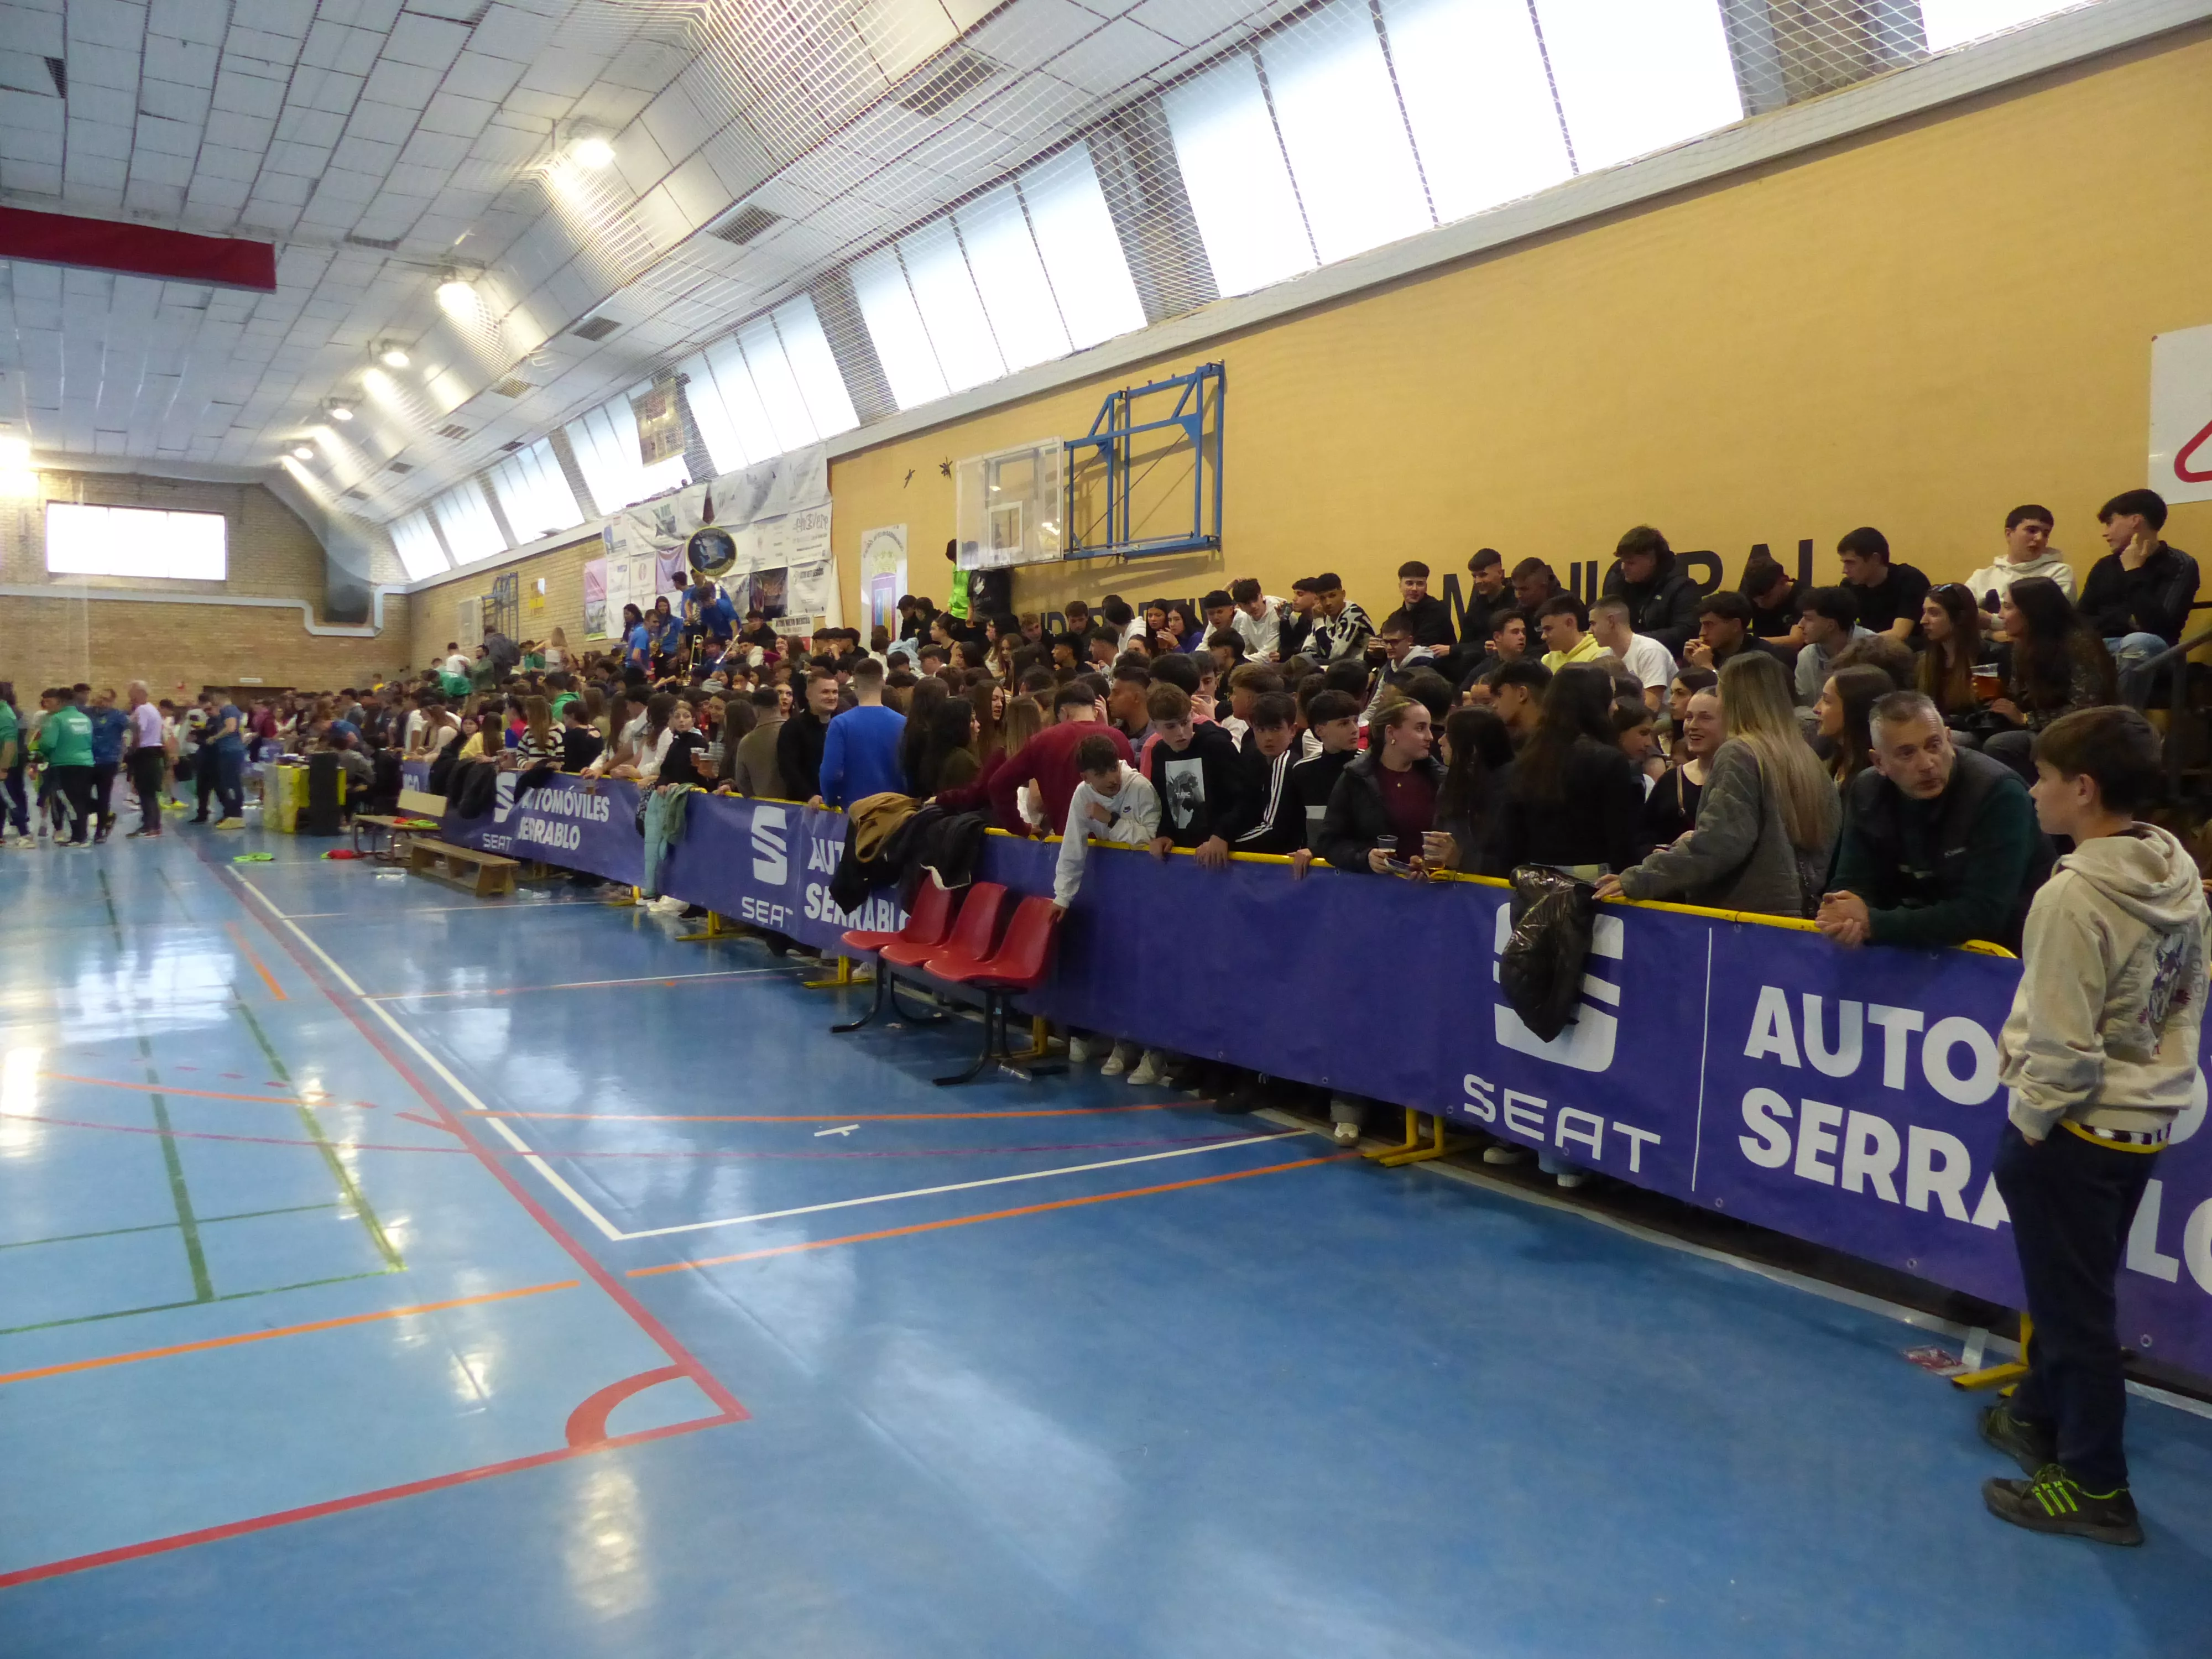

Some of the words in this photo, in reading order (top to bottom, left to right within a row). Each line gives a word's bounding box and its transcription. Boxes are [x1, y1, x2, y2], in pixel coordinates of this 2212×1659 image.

[522, 785, 611, 823] ATOMÓVILES
[482, 833, 513, 852] SEAT
[1463, 1073, 1661, 1173] SEAT
